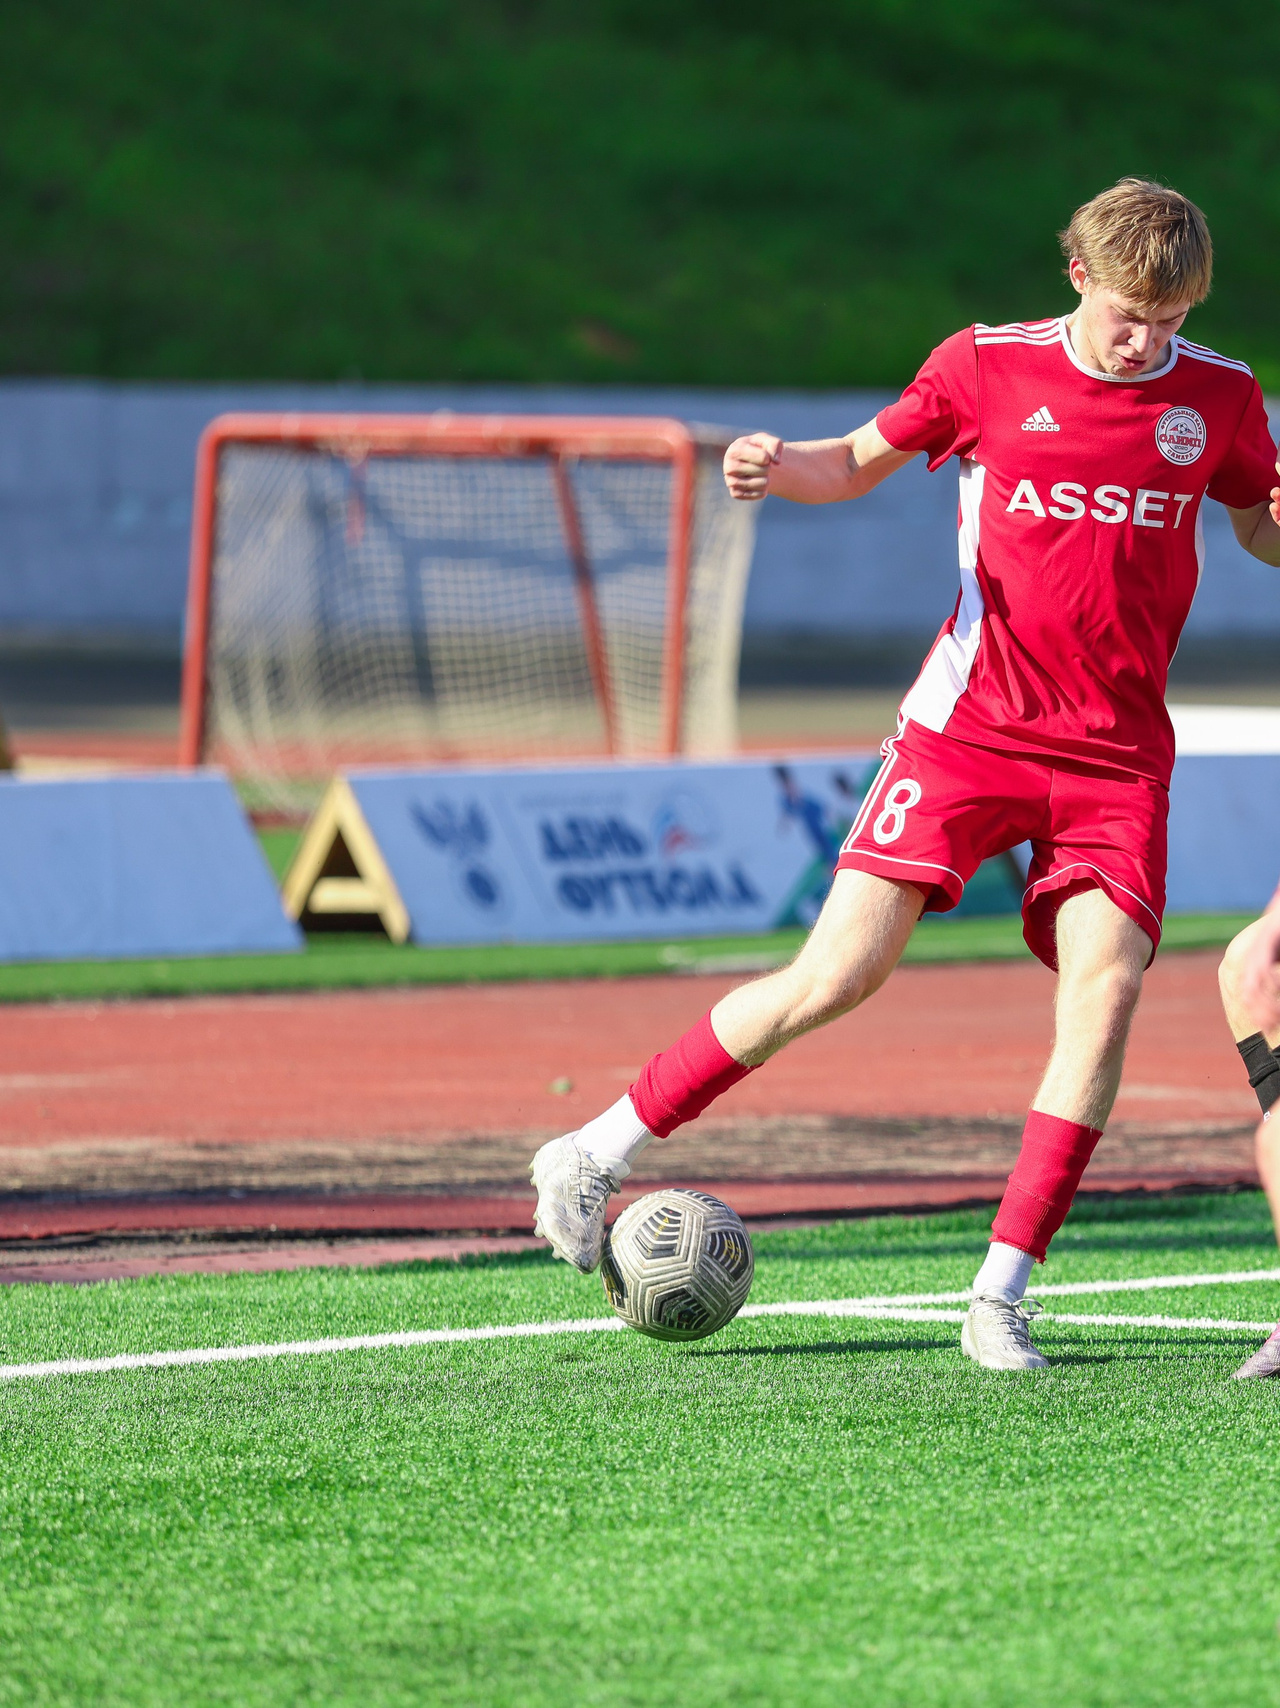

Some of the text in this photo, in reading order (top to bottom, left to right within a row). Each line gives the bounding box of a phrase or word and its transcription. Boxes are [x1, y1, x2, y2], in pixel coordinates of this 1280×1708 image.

[1021, 422, 1060, 432] adidas
[1167, 449, 1194, 460] САМАРА
[1005, 479, 1194, 529] ASSET
[873, 778, 922, 845] 8
[541, 816, 645, 861] ДЕНЬ
[558, 866, 764, 914] ФУТБОЛА
